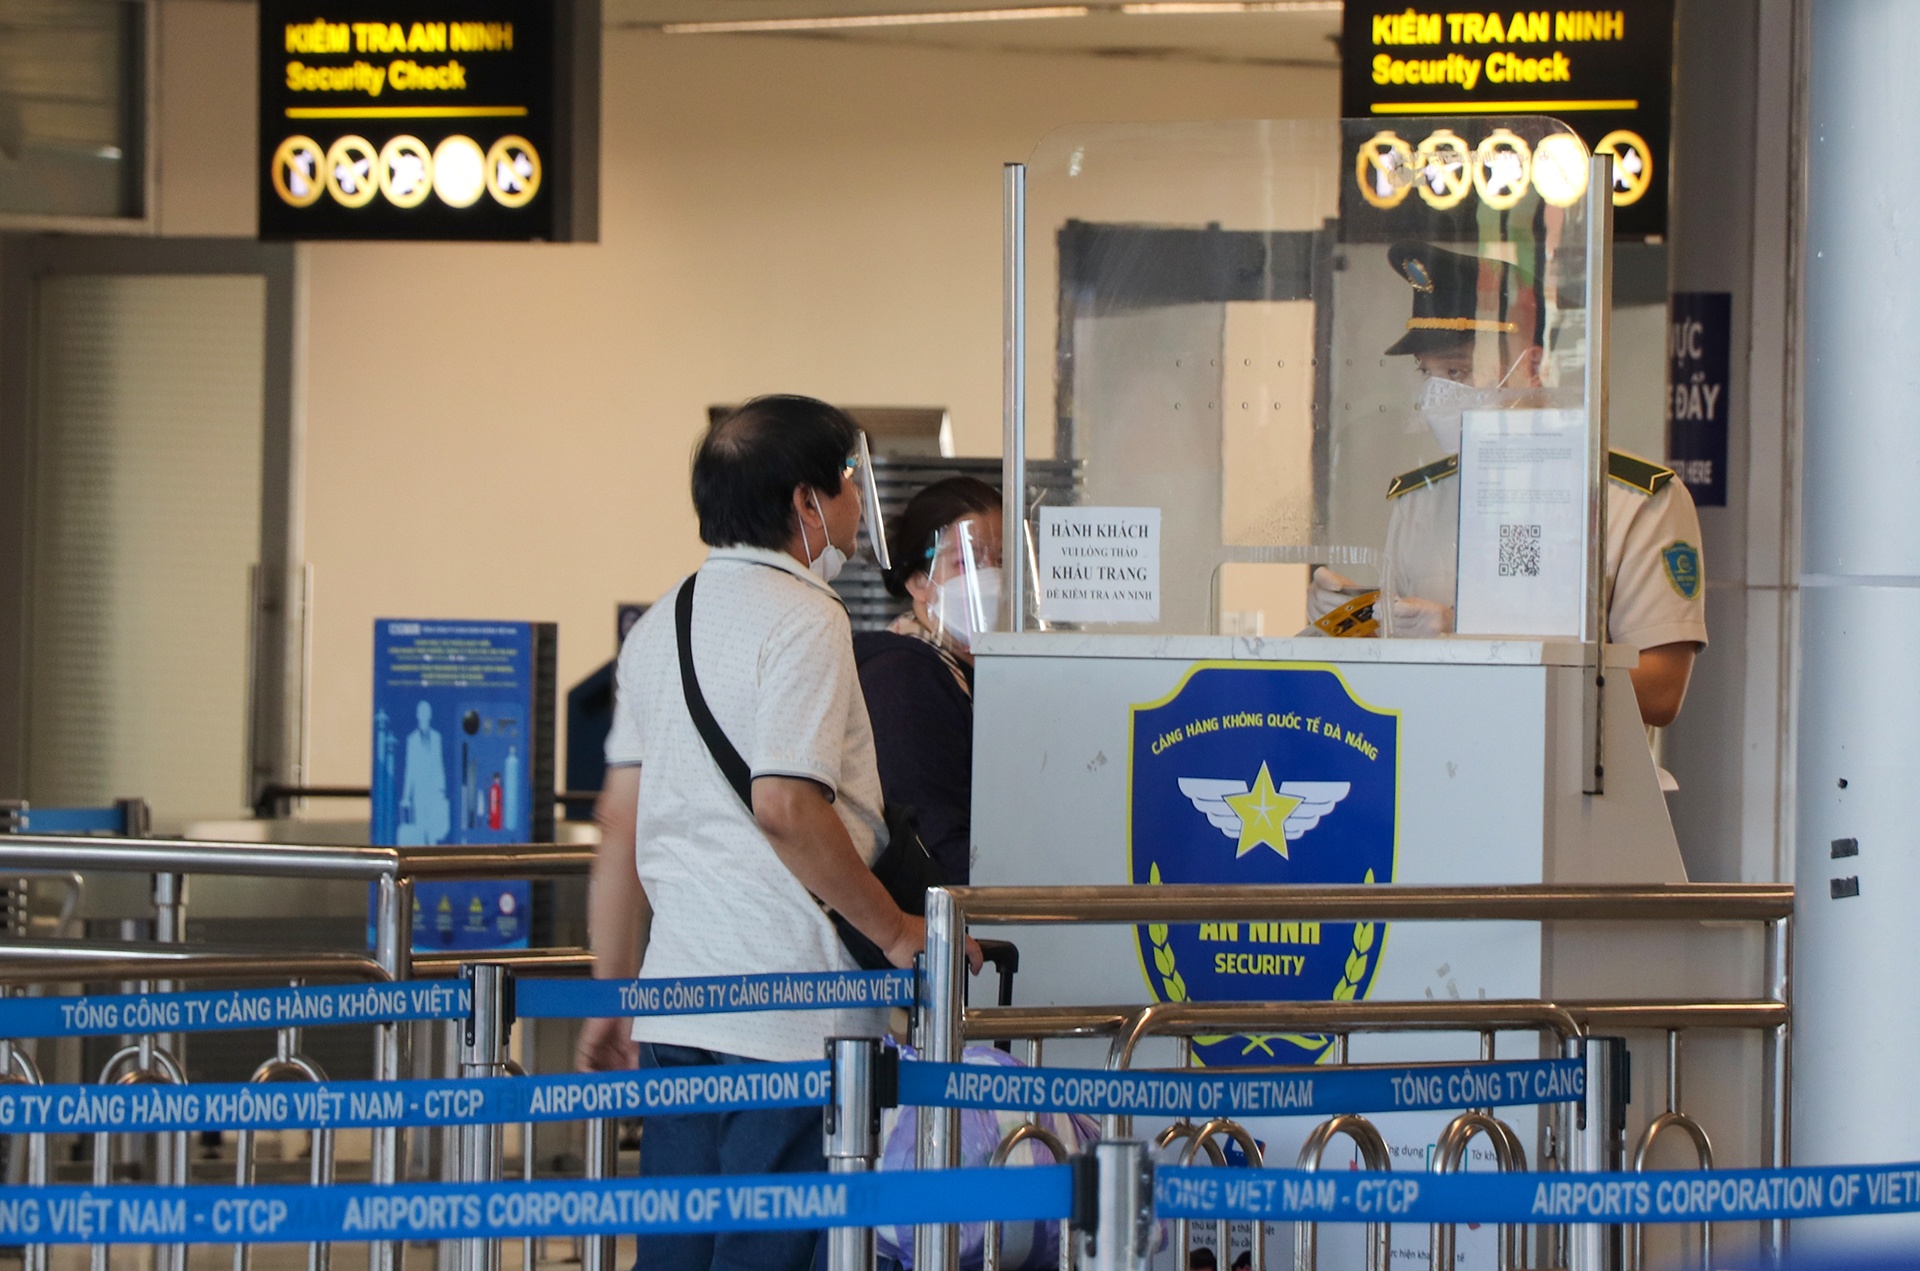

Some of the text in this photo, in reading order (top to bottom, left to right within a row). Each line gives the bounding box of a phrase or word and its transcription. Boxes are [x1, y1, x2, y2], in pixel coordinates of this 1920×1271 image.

[352, 22, 407, 53] TRA
[407, 21, 447, 53] AN
[449, 21, 514, 52] NINH
[1447, 11, 1505, 44] TRA
[1506, 11, 1549, 43] AN
[1555, 10, 1624, 41] NINH
[286, 59, 466, 97] Security Check
[1372, 50, 1571, 90] Security Check
[1051, 520, 1149, 538] HÀNH KHÁCH
[1061, 546, 1080, 557] VUI
[1097, 567, 1147, 581] TRANG
[1091, 590, 1109, 600] TRA
[1113, 590, 1125, 600] AN
[1128, 590, 1152, 601] NINH
[1185, 717, 1219, 738] HÀNG
[1222, 711, 1263, 729] KHÔNG
[1267, 711, 1302, 730] QUỐC
[1306, 716, 1321, 733] TẾ
[1323, 723, 1342, 740] ĐÀ
[1214, 953, 1305, 976] SECURITY
[123, 995, 180, 1028] CÔNG
[185, 1001, 208, 1024] TY
[215, 991, 271, 1023] CẢNG
[277, 990, 333, 1021] HÀNG
[338, 987, 406, 1018] KHÔNG
[412, 983, 454, 1017] VIỆT
[663, 982, 704, 1009] CÔNG
[707, 984, 726, 1007] TY
[729, 976, 769, 1006] CẢNG
[773, 975, 813, 1004] HÀNG
[817, 975, 867, 1003] KHÔNG
[870, 973, 901, 1005] VIỆT
[21, 1095, 52, 1124] TY
[58, 1087, 125, 1124] CẢNG
[132, 1087, 199, 1123] HÀNG
[205, 1088, 288, 1122] KHÔNG
[293, 1085, 344, 1127] VIỆT
[350, 1091, 401, 1120] NAM
[425, 1089, 484, 1118] CTCP
[529, 1081, 640, 1114] AIRPORTS
[644, 1072, 799, 1107] CORPORATION
[804, 1070, 831, 1098] OF
[945, 1072, 1046, 1105] AIRPORTS
[1051, 1077, 1192, 1110] CORPORATION
[1198, 1082, 1224, 1110] OF
[1228, 1080, 1314, 1109] VIETNAM
[1448, 1068, 1501, 1103] CÔNG
[1506, 1071, 1529, 1098] TY
[47, 1190, 113, 1240] VIỆT
[119, 1198, 186, 1234] NAM
[212, 1199, 287, 1233] CTCP
[342, 1194, 481, 1231] AIRPORTS
[487, 1188, 680, 1227] CORPORATION
[685, 1188, 721, 1222] OF
[726, 1184, 847, 1219] VIETNAM
[1282, 1179, 1336, 1213] NAM
[1356, 1179, 1420, 1213] CTCP
[1531, 1180, 1649, 1215] AIRPORTS
[1656, 1176, 1822, 1214] CORPORATION
[1829, 1174, 1860, 1208] OF
